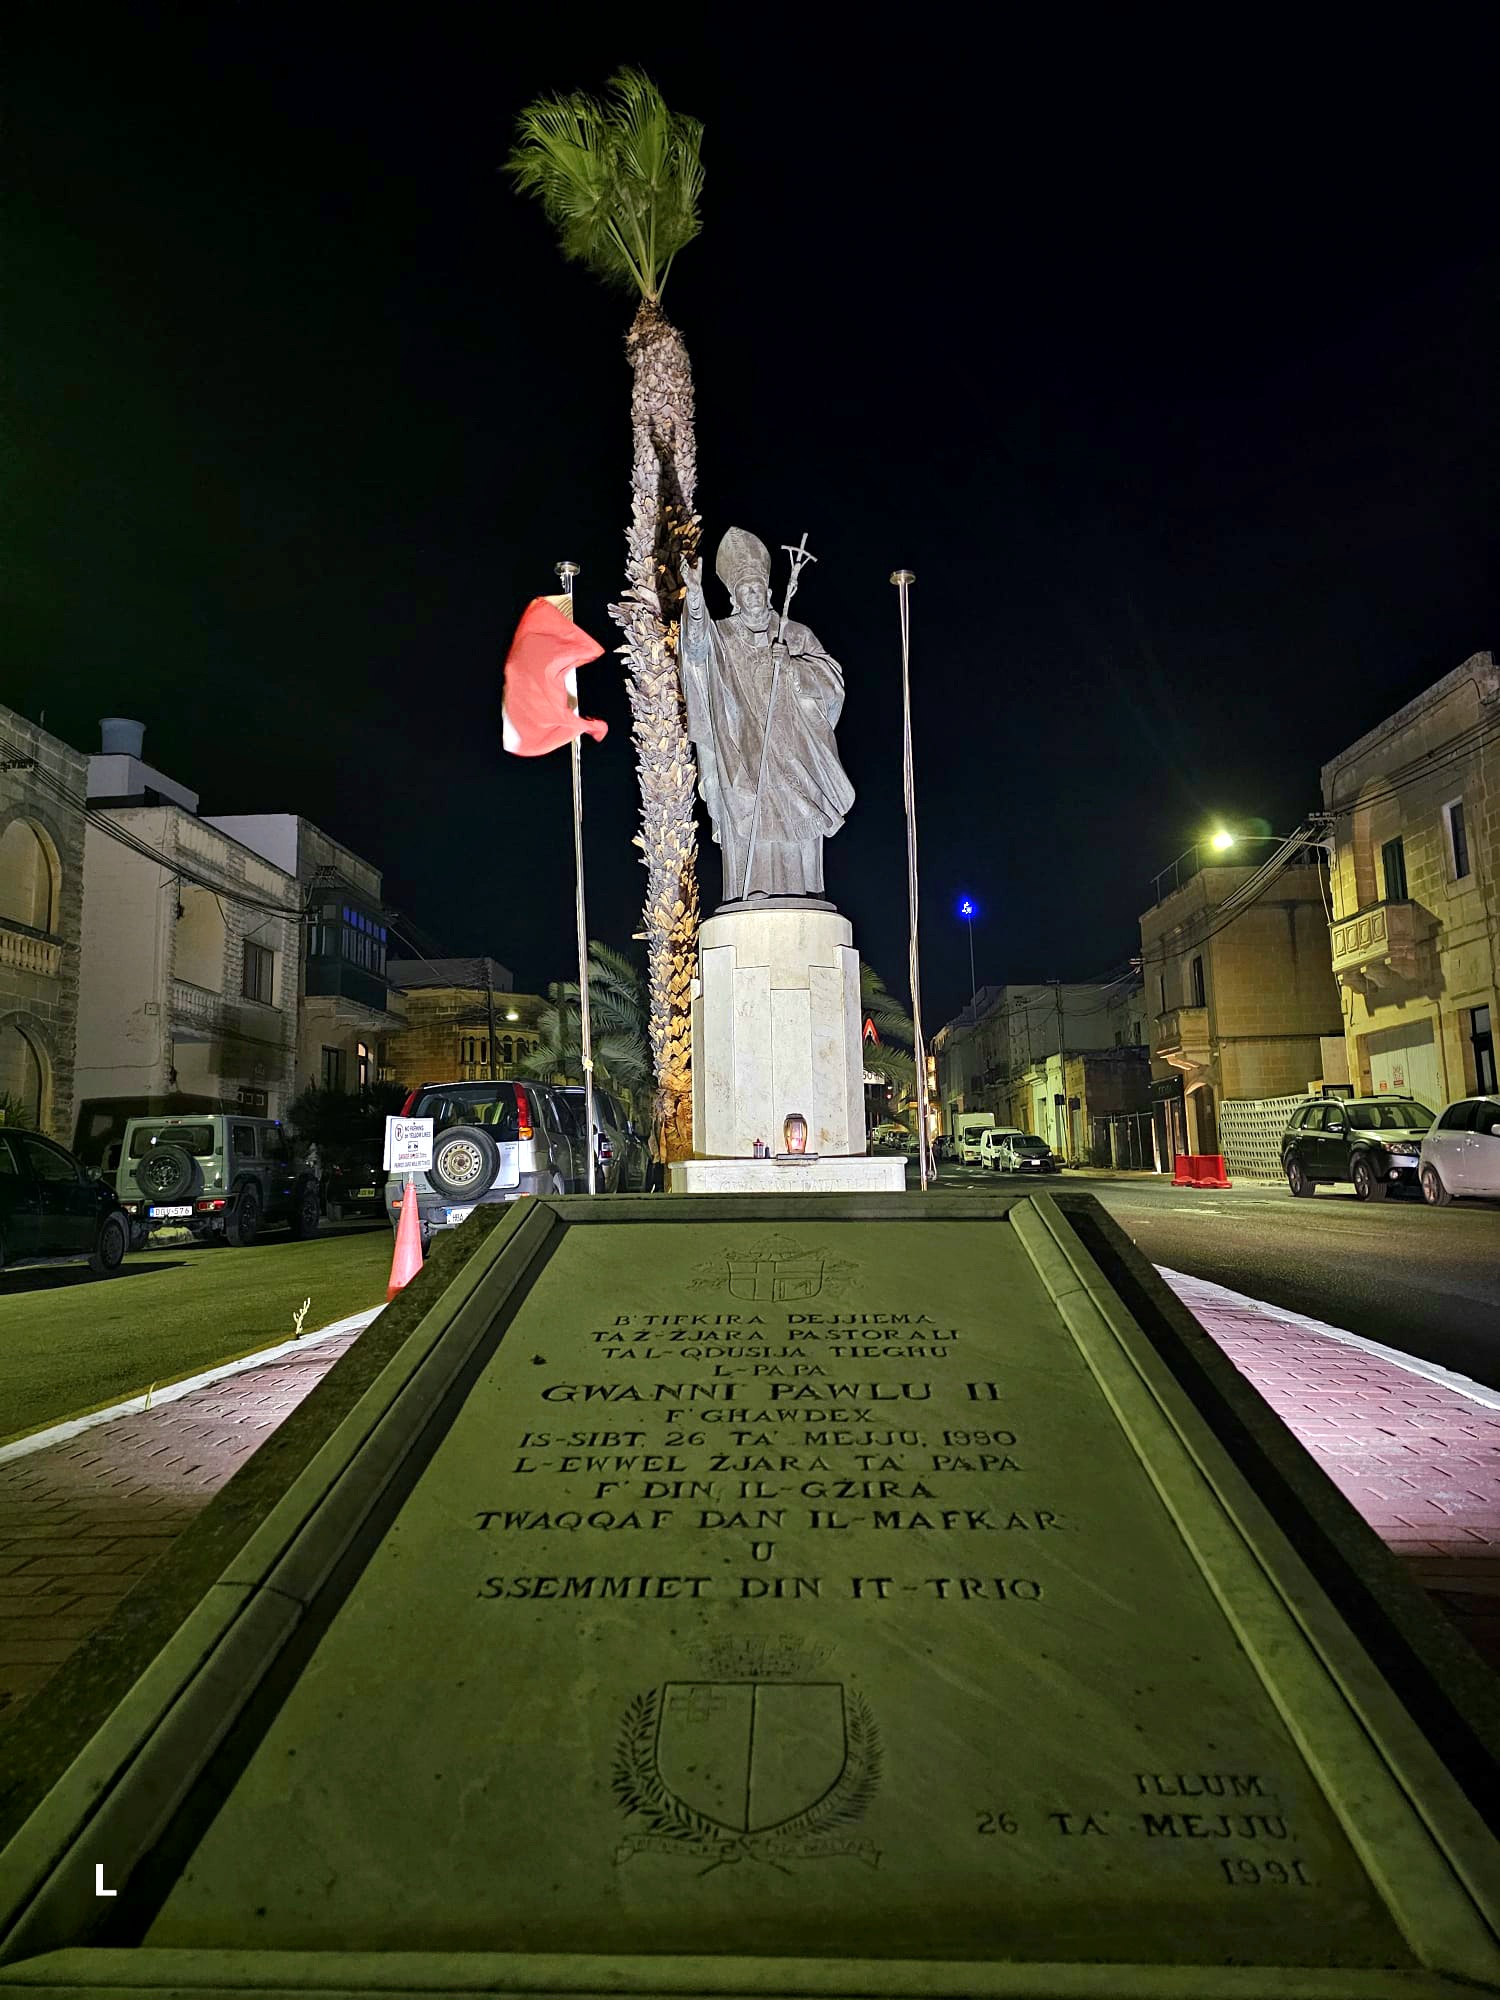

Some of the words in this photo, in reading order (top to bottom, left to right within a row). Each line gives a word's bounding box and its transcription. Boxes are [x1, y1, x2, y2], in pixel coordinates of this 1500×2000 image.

[787, 1313, 936, 1325] DEJJIEMA
[788, 1329, 961, 1341] PASTORALI
[601, 1346, 807, 1359] TAL-QDUSIJA
[713, 1363, 828, 1377] L-PAPA
[770, 1383, 932, 1401] PAWLU
[963, 1382, 1003, 1401] II
[664, 1431, 706, 1447] 26
[728, 1431, 780, 1446] TA'
[941, 1430, 1017, 1446] 1990
[512, 1455, 688, 1473] L-EWWEL
[930, 1454, 1022, 1472] PAPA
[474, 1510, 673, 1532] TWAQQAF
[698, 1509, 788, 1530] DAN
[750, 1541, 776, 1562] U
[476, 1576, 712, 1600] SSEMMIET
[739, 1576, 823, 1600] DIN
[850, 1576, 1043, 1601] IT-TRIQ
[976, 1811, 1018, 1836] 26
